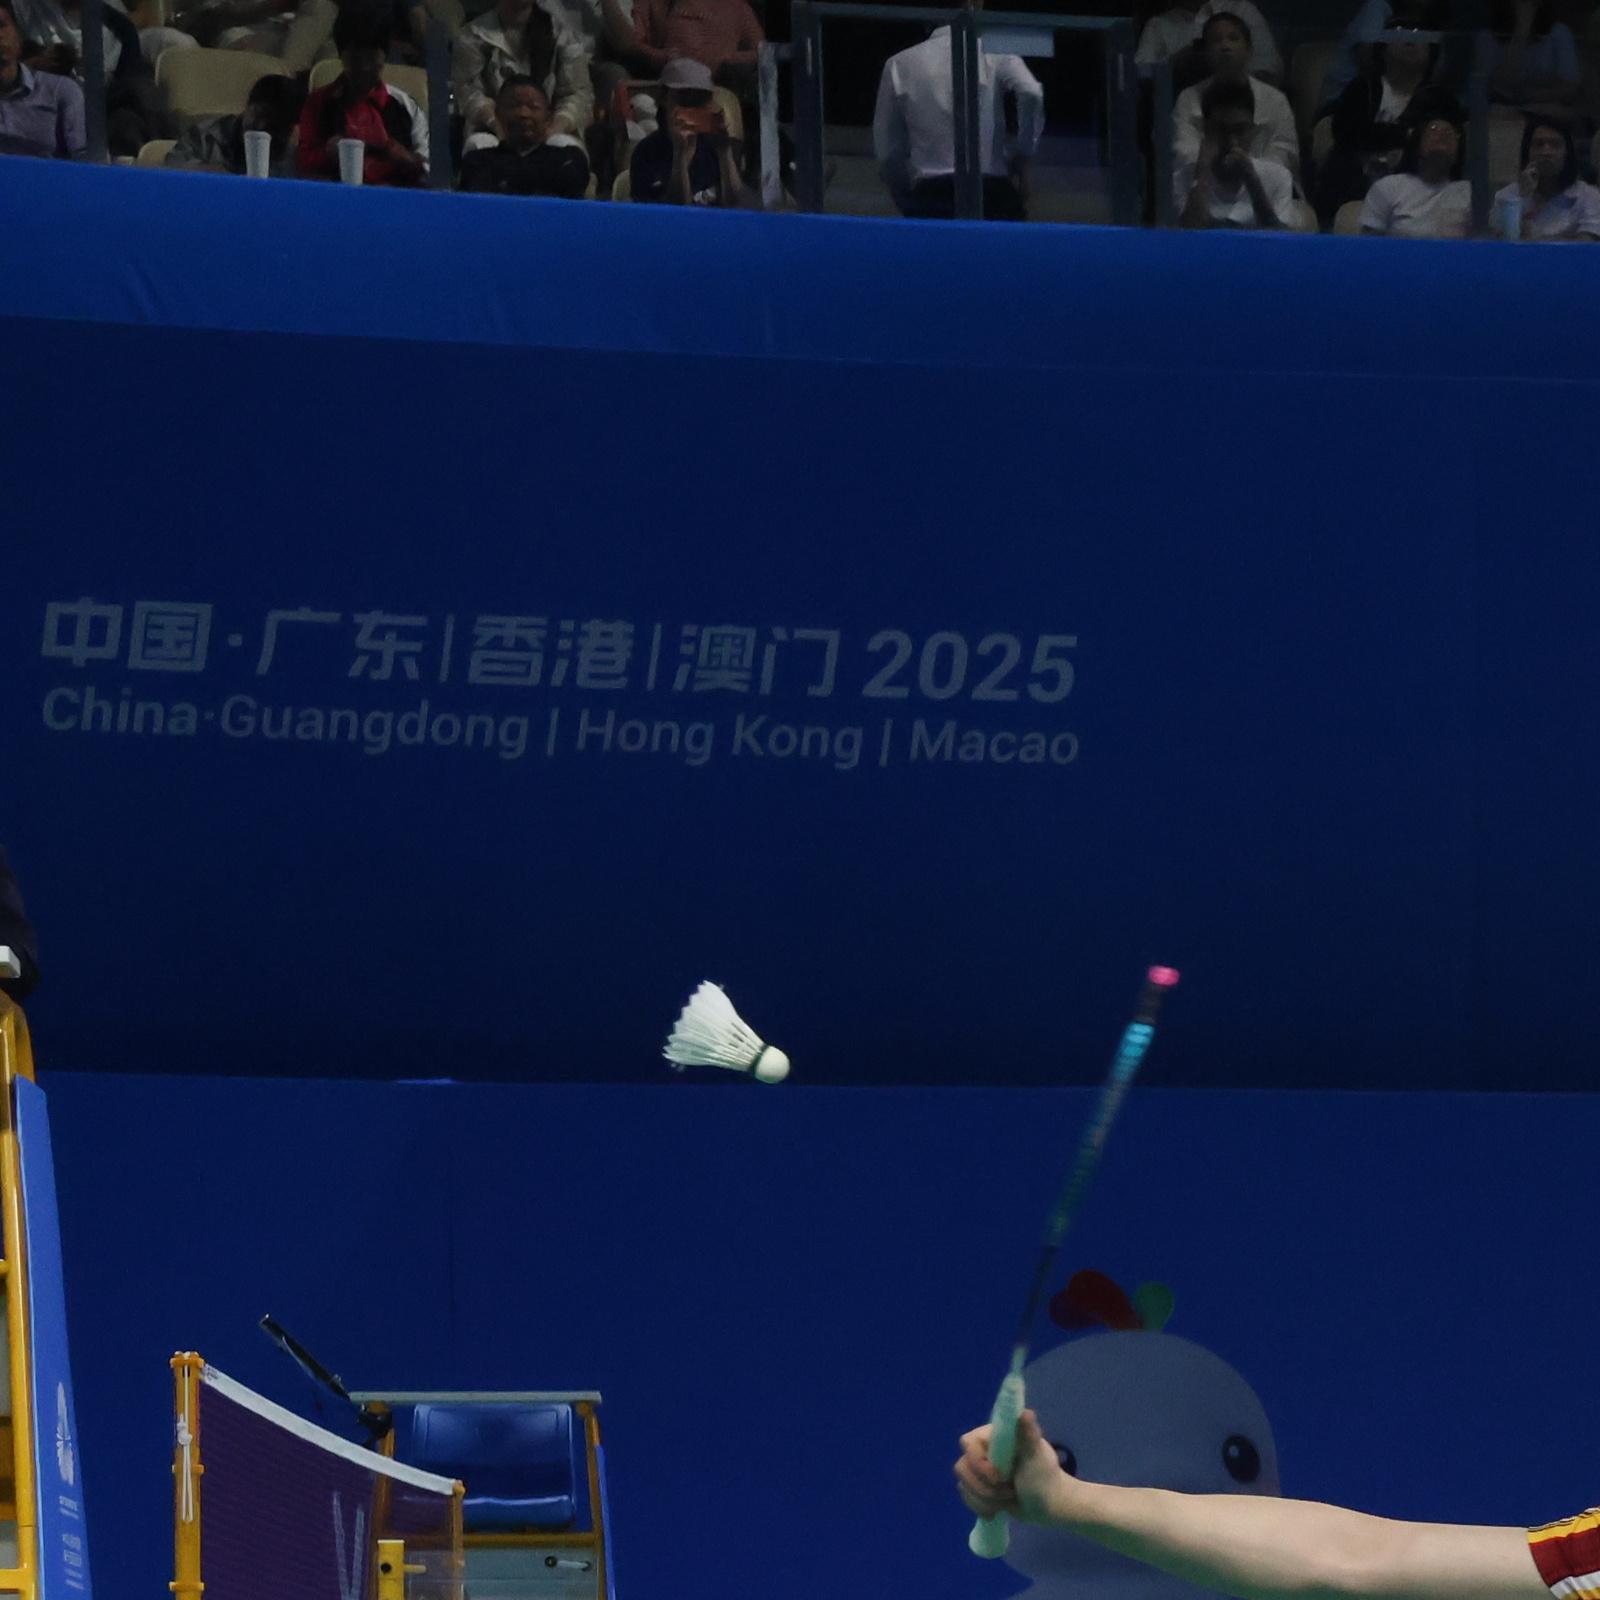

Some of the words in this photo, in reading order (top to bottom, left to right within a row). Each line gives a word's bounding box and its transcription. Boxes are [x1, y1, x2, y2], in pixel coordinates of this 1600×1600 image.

[862, 628, 1080, 704] 2025
[577, 708, 714, 767] Hong
[732, 712, 864, 770] Kong
[909, 719, 1081, 765] Macao
